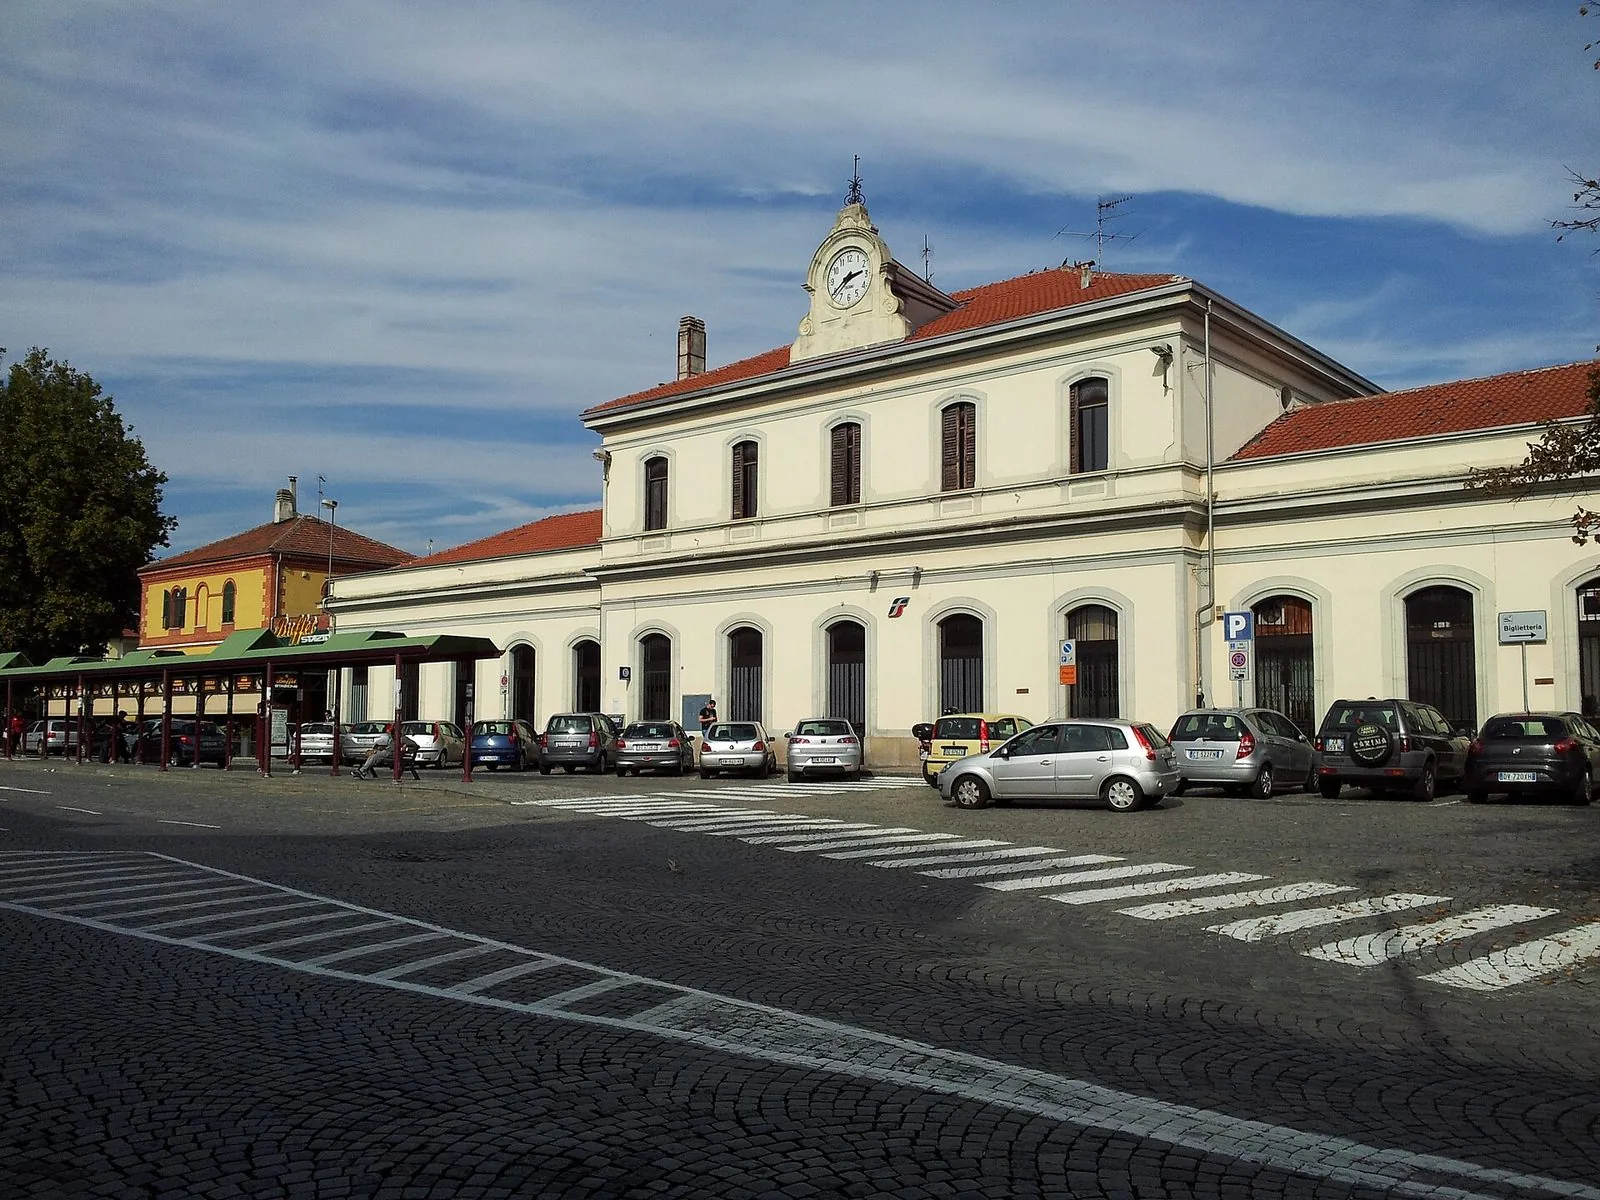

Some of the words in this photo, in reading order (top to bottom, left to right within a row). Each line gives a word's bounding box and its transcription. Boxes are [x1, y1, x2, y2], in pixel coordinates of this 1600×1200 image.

[839, 258, 845, 267] 11
[847, 255, 853, 263] 12
[862, 260, 866, 268] 2
[833, 267, 839, 275] 10
[861, 281, 866, 289] 4
[855, 289, 859, 297] 5
[839, 293, 843, 302] 7
[273, 613, 318, 647] Buffet
[1229, 615, 1246, 639] P
[1503, 624, 1542, 632] Biglietteria
